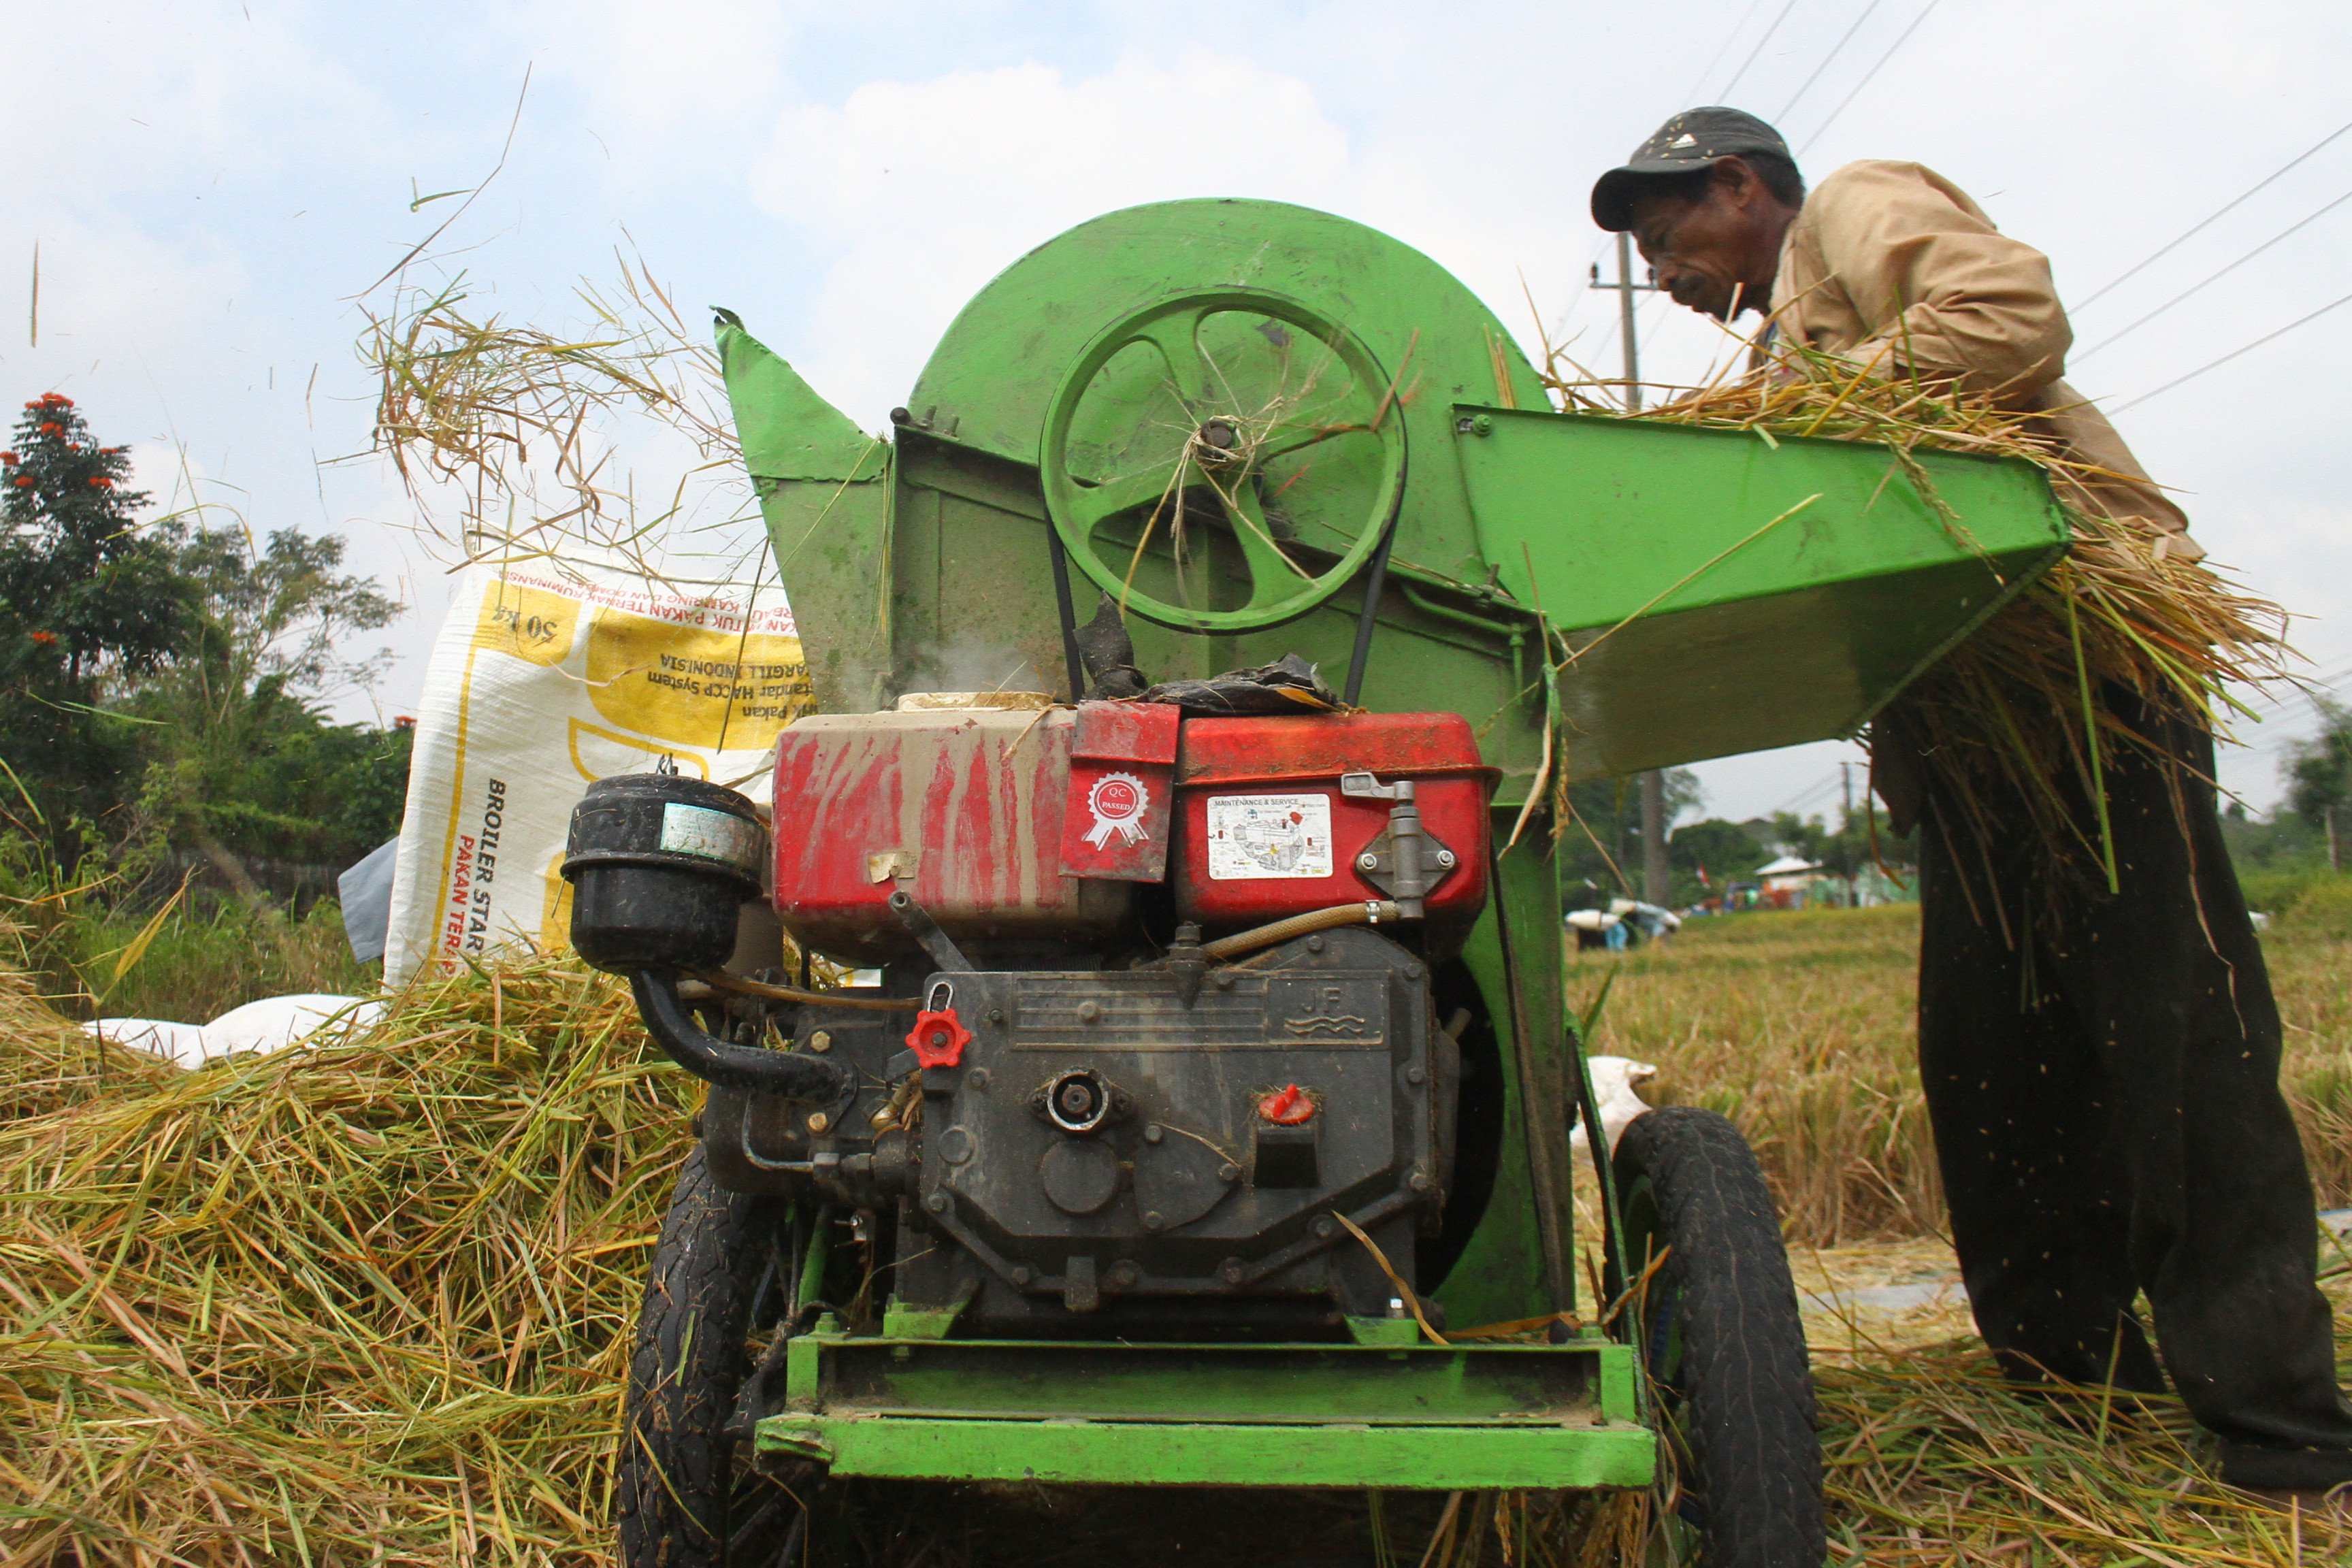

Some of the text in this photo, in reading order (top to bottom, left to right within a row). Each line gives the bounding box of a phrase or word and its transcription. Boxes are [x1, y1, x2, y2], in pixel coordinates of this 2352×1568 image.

[586, 593, 644, 613] TERNAK
[648, 602, 704, 625] PAKAN
[525, 615, 557, 642] 50
[748, 664, 808, 679] ARGILL
[647, 670, 812, 700] tandar HACCP System
[742, 704, 787, 721] Pakan
[1109, 787, 1127, 798] QC
[1102, 802, 1130, 811] PASSED
[451, 834, 474, 905] PAKAN
[466, 778, 506, 959] BROILER STAR
